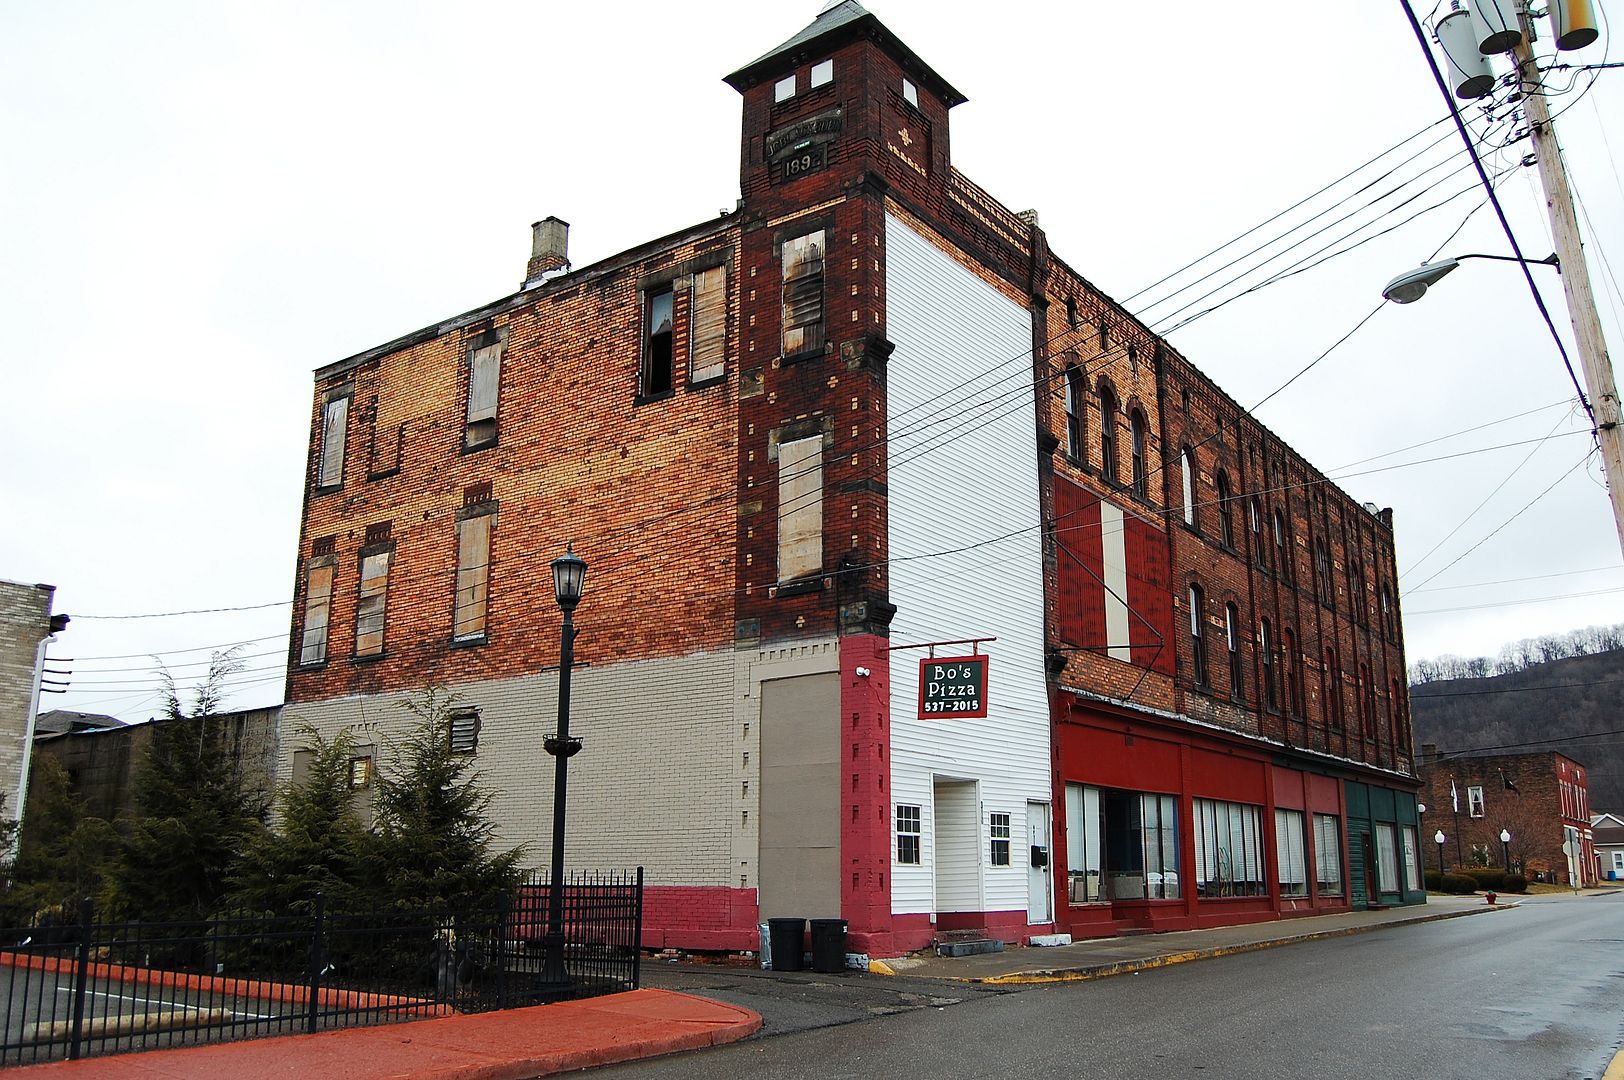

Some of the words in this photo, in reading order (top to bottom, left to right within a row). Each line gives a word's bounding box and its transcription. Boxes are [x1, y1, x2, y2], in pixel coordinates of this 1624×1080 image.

[934, 664, 971, 680] Bo's
[928, 682, 975, 697] Pizza
[925, 700, 978, 712] 537-2015
